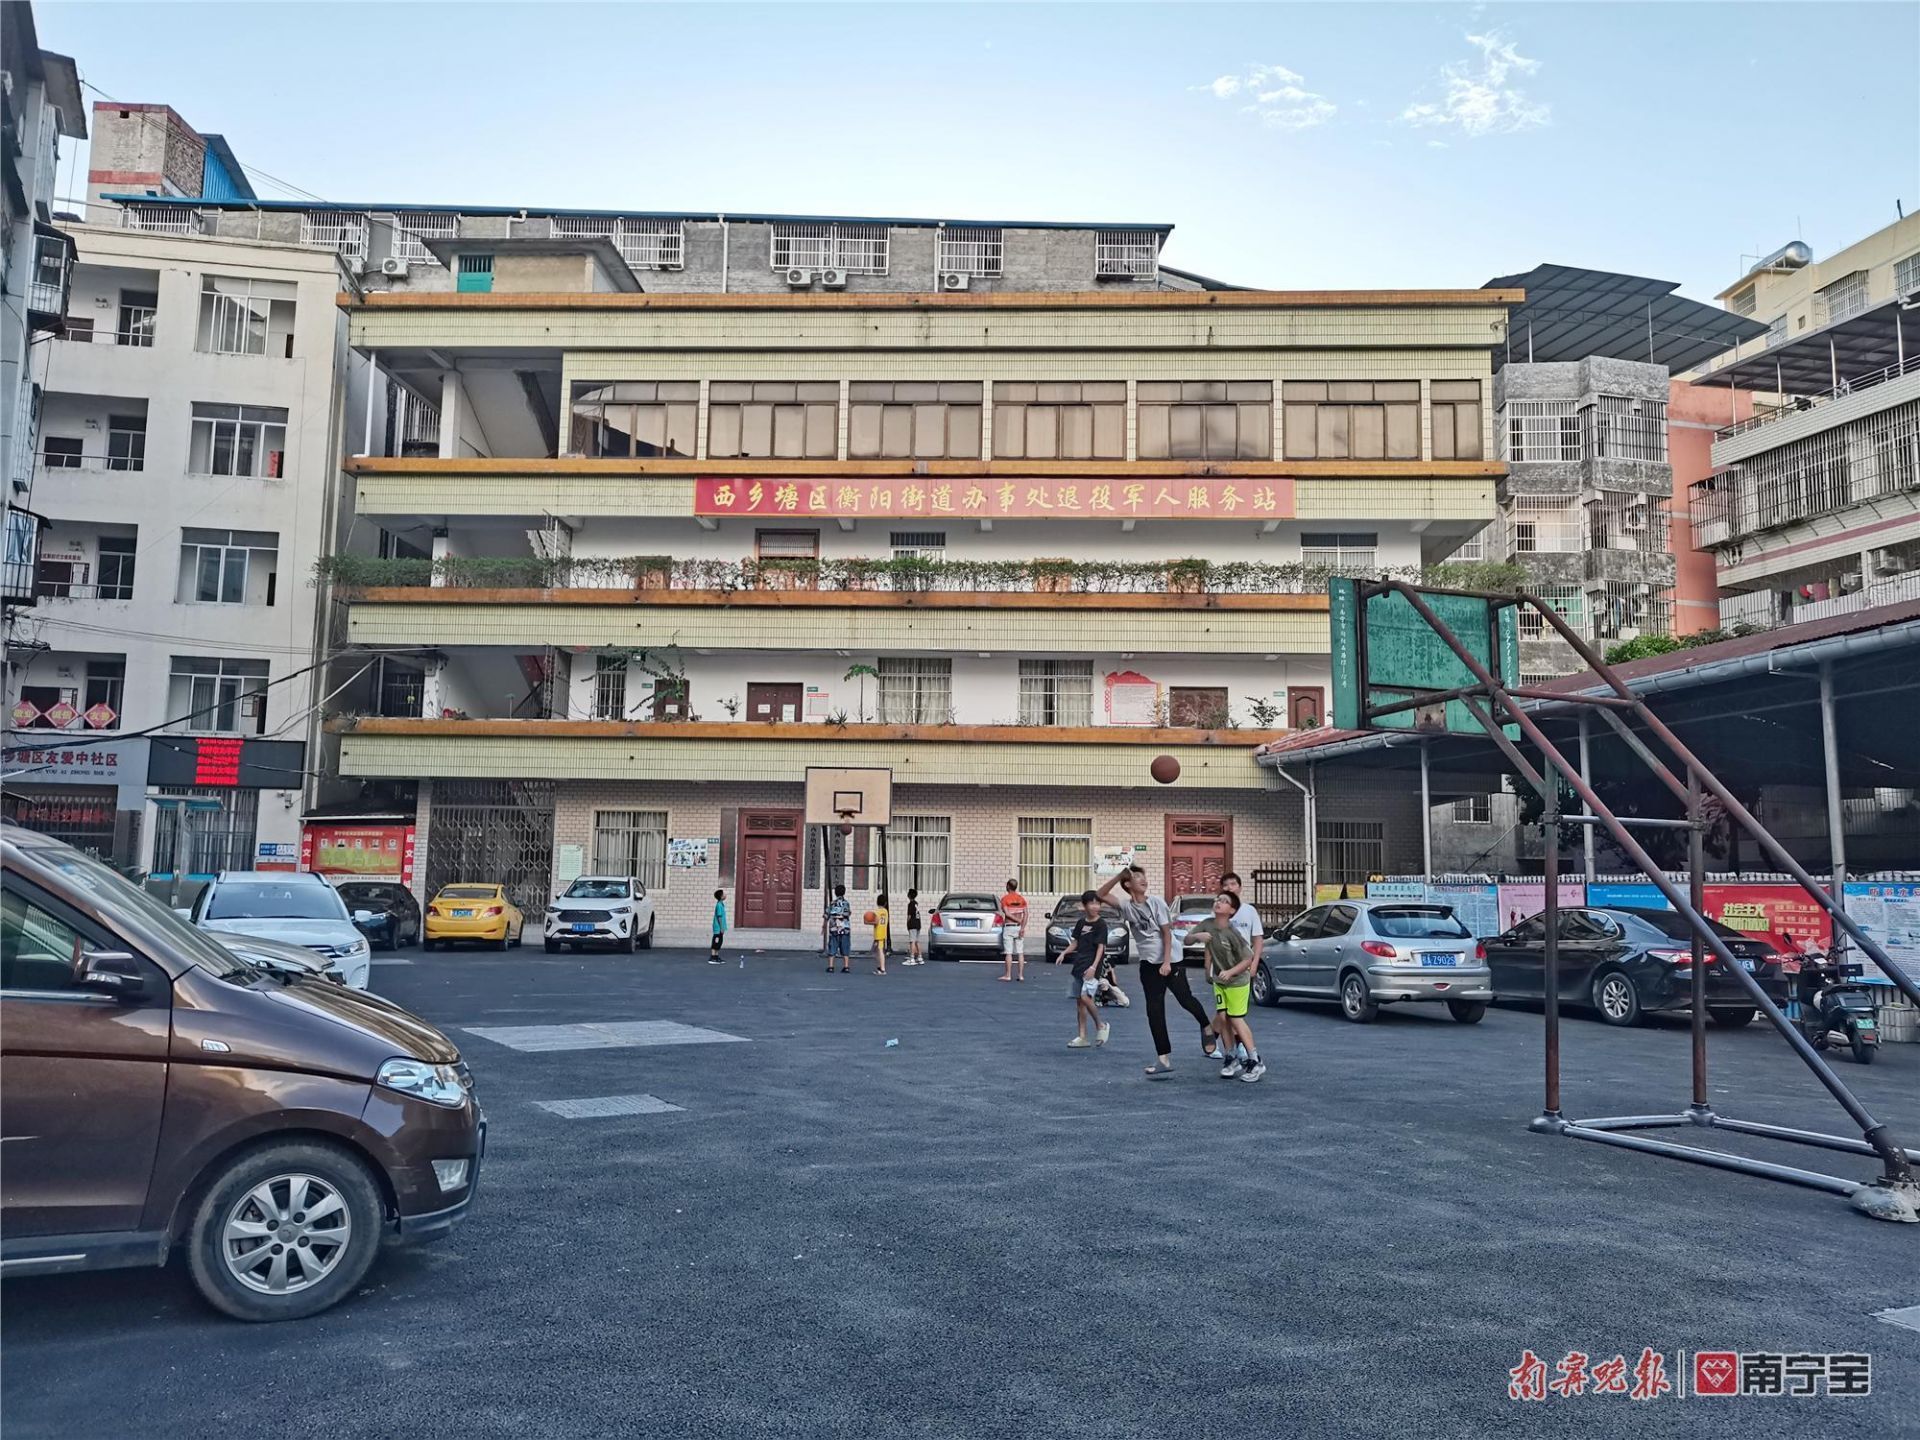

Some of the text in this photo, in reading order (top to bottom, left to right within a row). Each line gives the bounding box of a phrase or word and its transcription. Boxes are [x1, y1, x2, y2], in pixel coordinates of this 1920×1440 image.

[713, 482, 1277, 512] 西乡塘区衡阳街道办事处退役军人服务站
